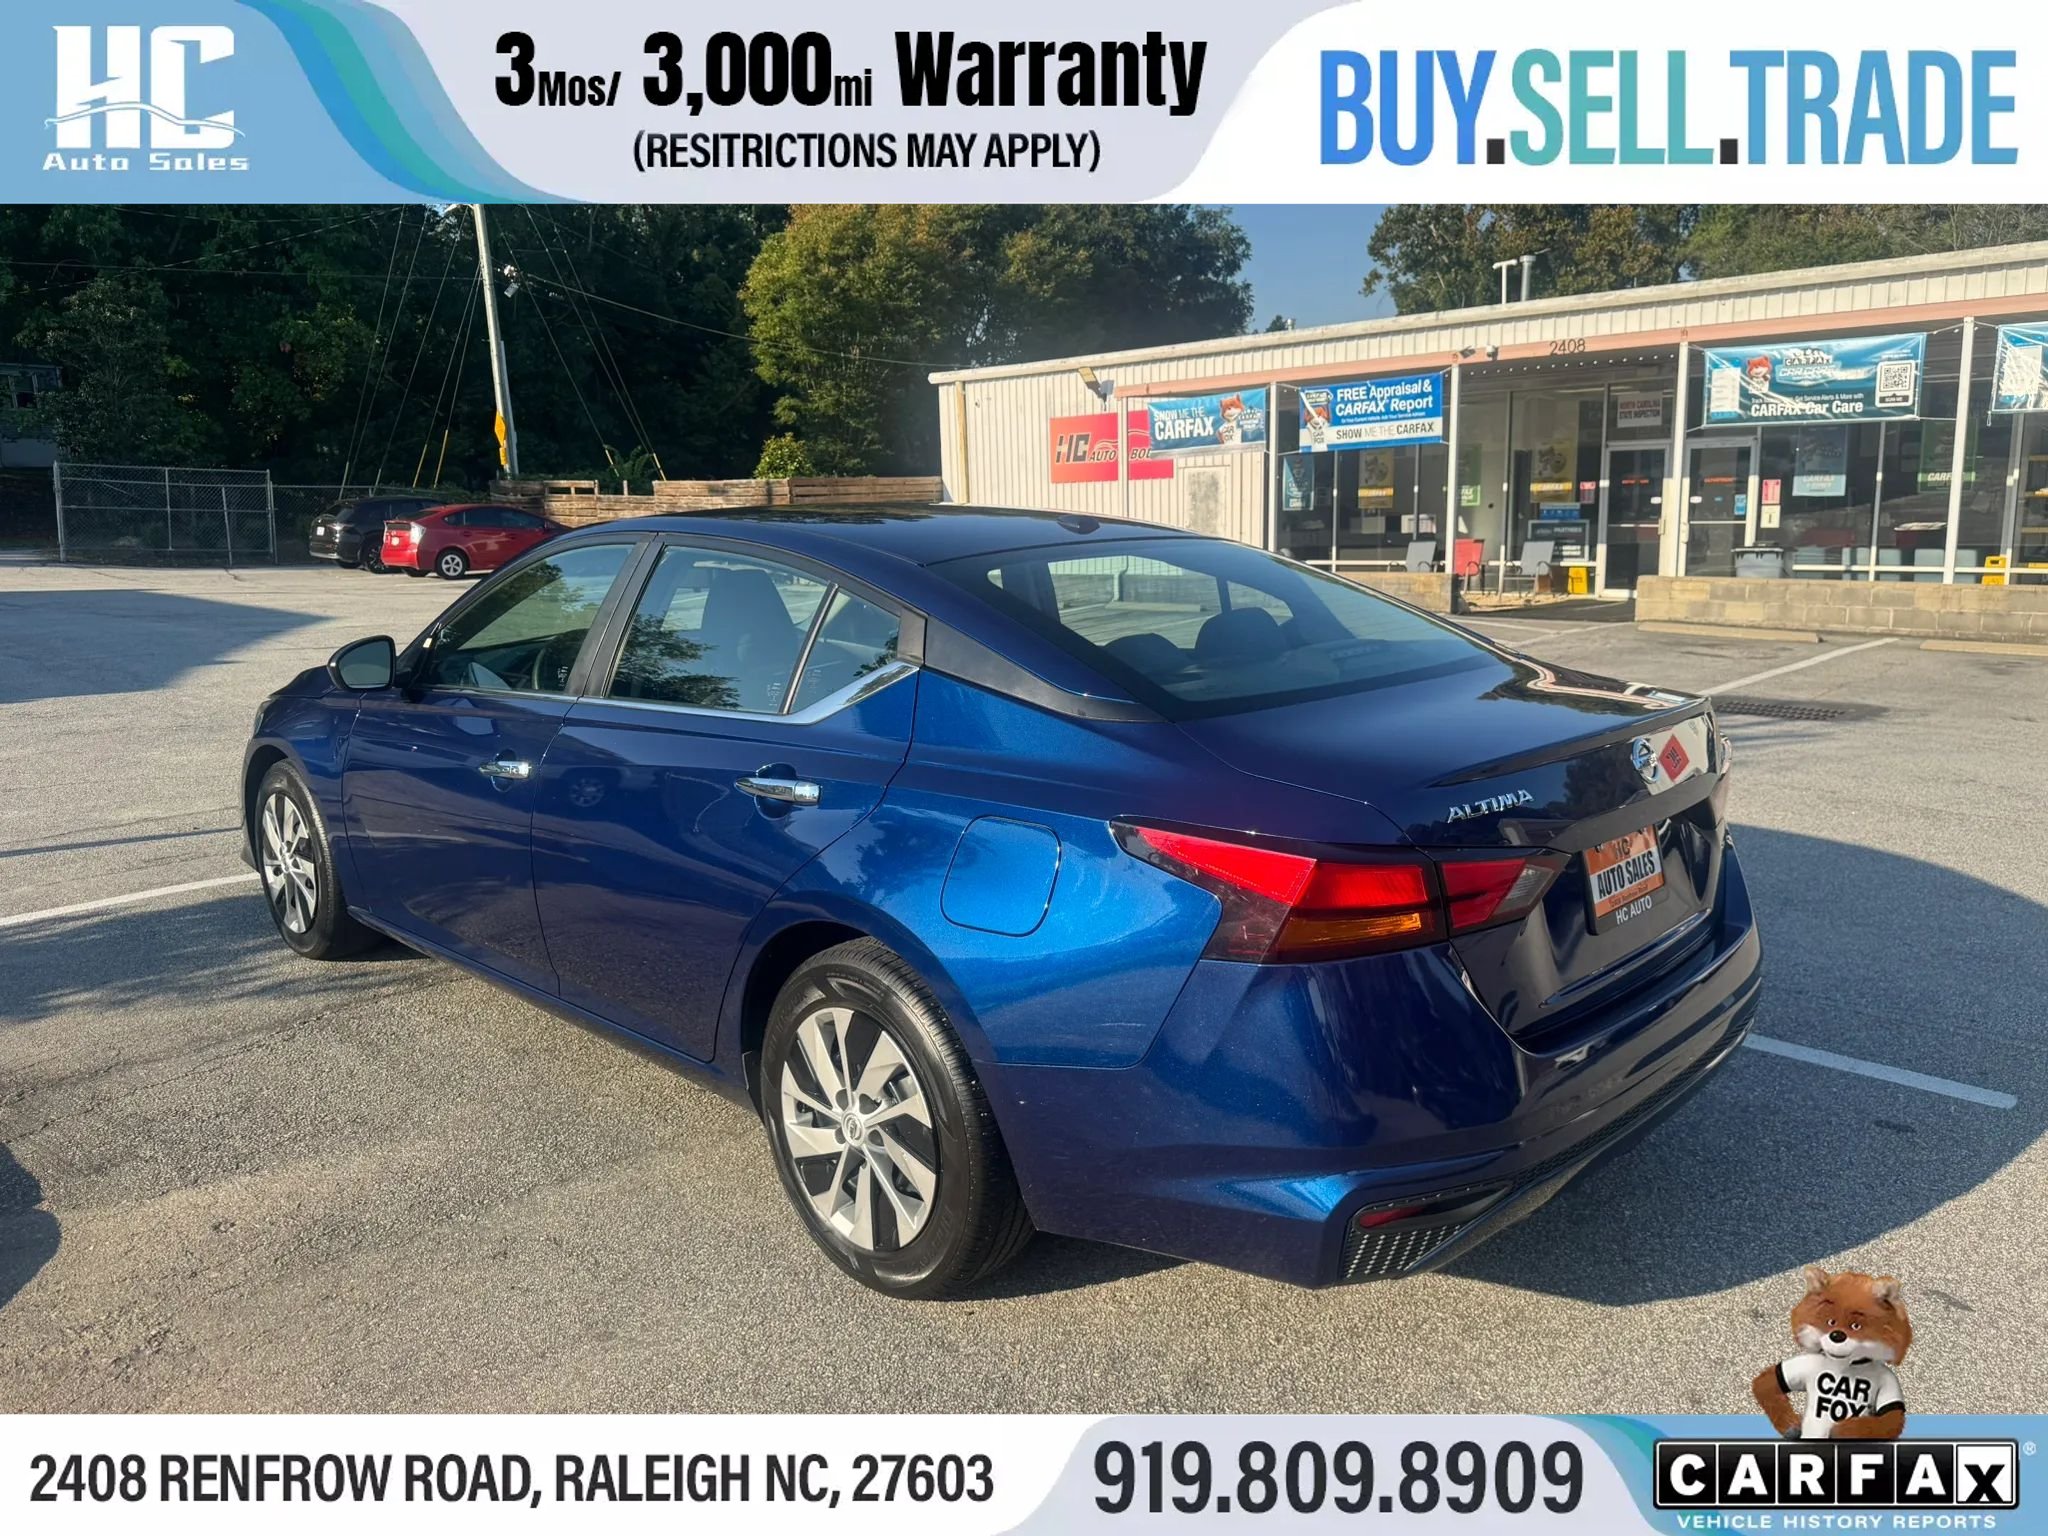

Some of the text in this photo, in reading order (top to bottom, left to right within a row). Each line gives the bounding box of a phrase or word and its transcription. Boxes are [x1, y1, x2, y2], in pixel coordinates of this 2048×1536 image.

[1549, 338, 1585, 356] 2408
[1337, 386, 1368, 401] FREE
[1369, 379, 1421, 398] Appraisal
[1423, 379, 1433, 393] &
[1191, 406, 1206, 418] THE
[1335, 400, 1386, 417] CARFAX
[1390, 395, 1433, 412] Report
[1751, 400, 1863, 417] CARFAX Car Care
[1154, 416, 1215, 441] CARFAX
[1336, 422, 1434, 440] SHOW ME THE CARFAX
[1056, 433, 1090, 463] HC
[1089, 449, 1117, 462] AUTO
[1447, 789, 1534, 823] ALTIMA
[1614, 839, 1630, 860] HC
[1597, 863, 1625, 898] AUTO
[1625, 850, 1656, 885] SALES
[1615, 906, 1629, 925] HC
[1630, 895, 1653, 917] AUTO
